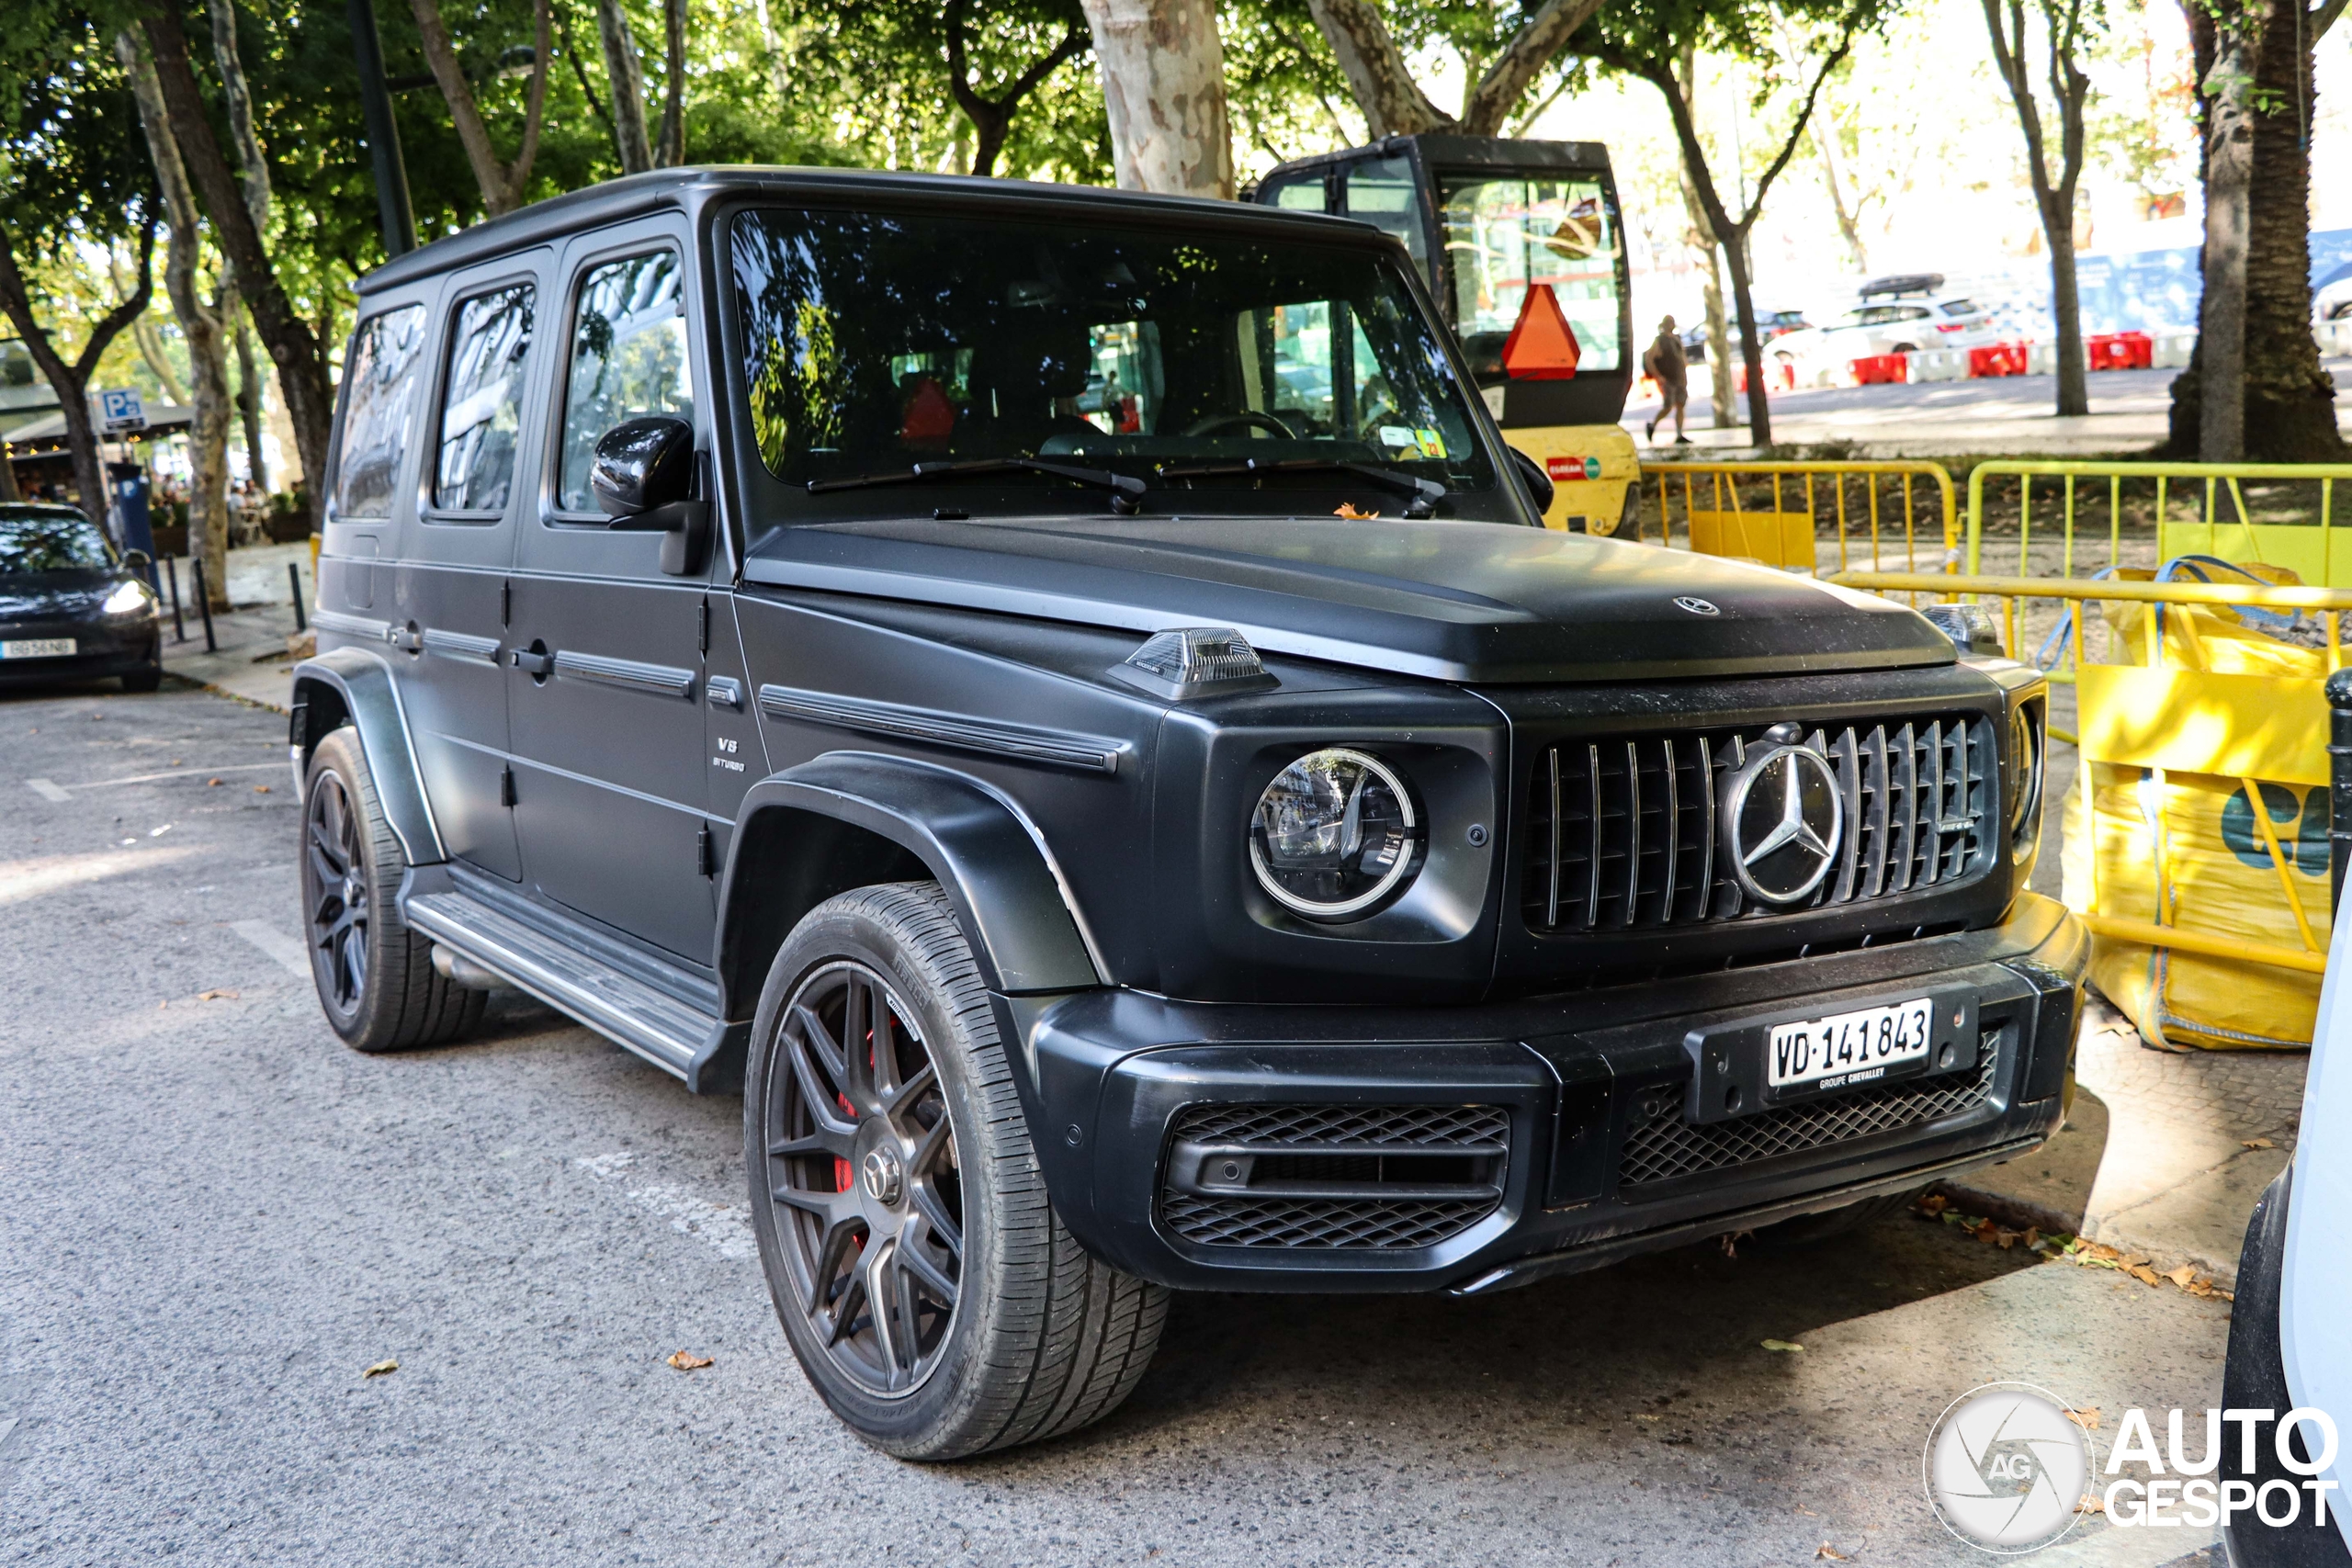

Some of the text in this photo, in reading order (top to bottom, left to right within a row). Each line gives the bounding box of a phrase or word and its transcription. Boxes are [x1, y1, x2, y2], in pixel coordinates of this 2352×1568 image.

[107, 394, 126, 417] P
[121, 480, 135, 497] P
[718, 737, 738, 753] V8
[712, 757, 745, 773] BITURBO
[891, 949, 932, 1010] PIRELLI
[1819, 1066, 1885, 1089] GROUPE CHEVALLEY
